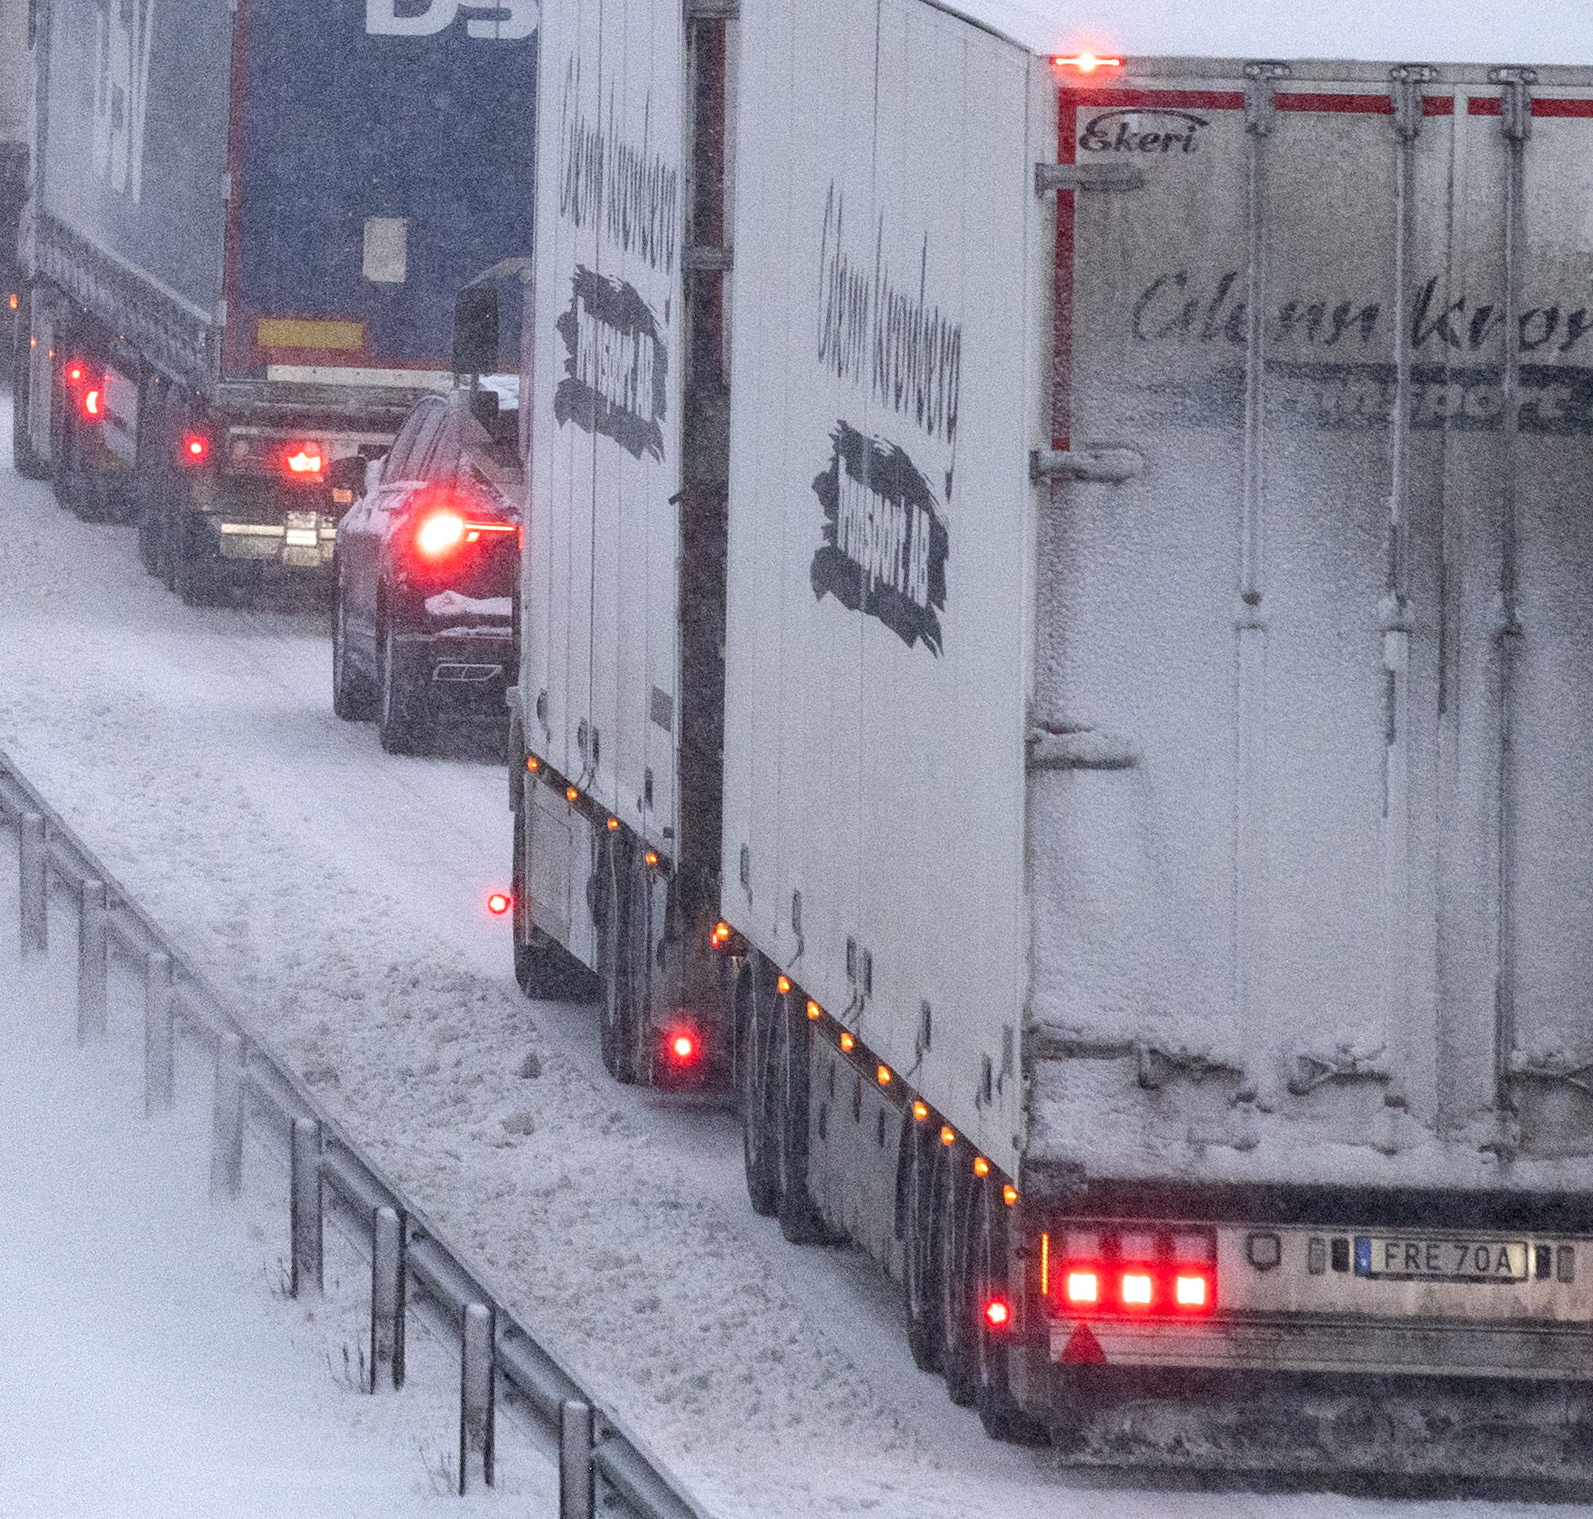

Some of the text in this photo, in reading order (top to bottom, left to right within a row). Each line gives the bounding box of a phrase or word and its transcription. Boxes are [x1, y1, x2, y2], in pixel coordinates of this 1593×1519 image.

[1079, 109, 1210, 154] Ekeri
[836, 455, 931, 609] Transport AB
[1384, 1241, 1513, 1274] FRE 70A
